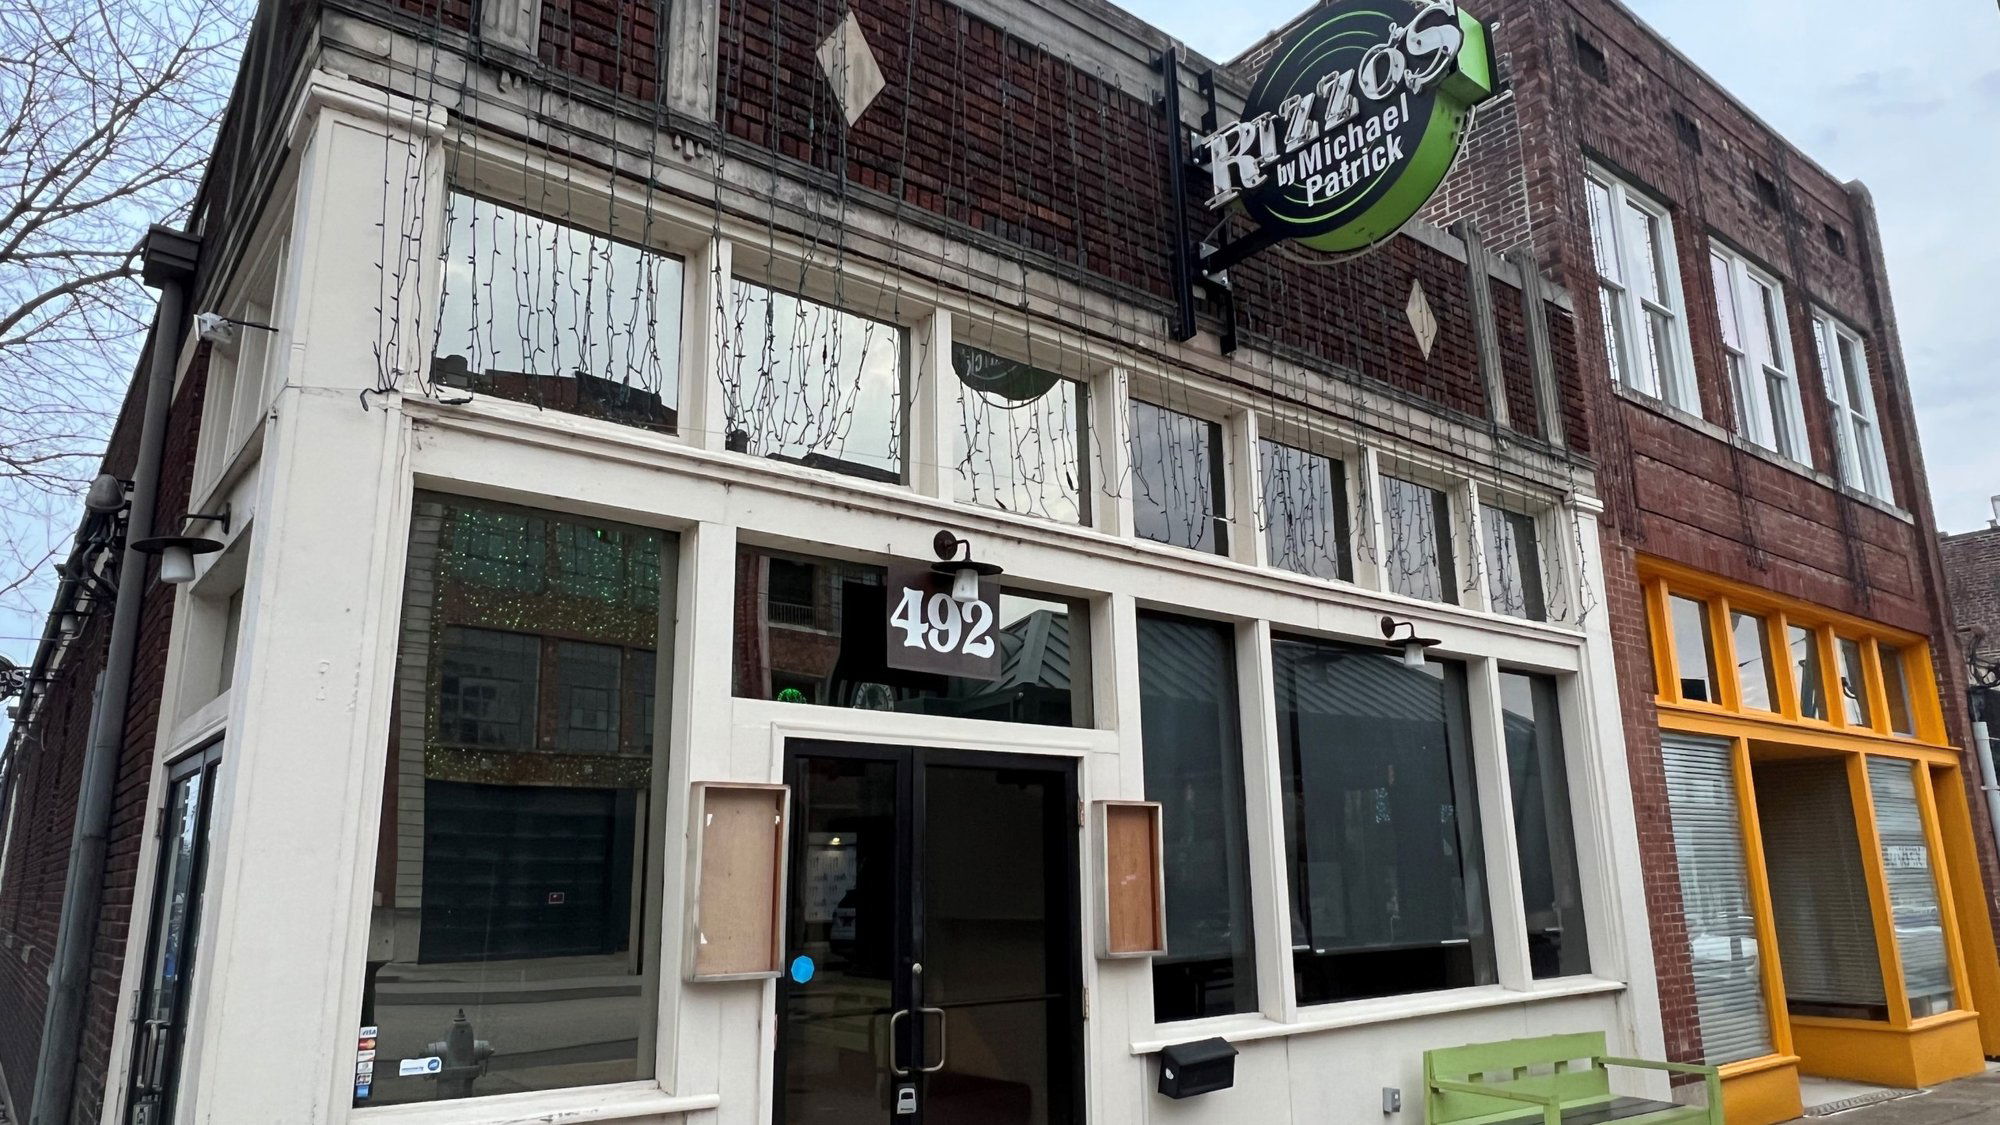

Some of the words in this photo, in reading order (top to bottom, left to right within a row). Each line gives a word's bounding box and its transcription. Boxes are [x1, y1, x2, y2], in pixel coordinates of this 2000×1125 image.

[1277, 160, 1295, 187] by
[1298, 92, 1409, 180] Michael
[1306, 133, 1404, 207] Patrick
[890, 587, 995, 659] 492
